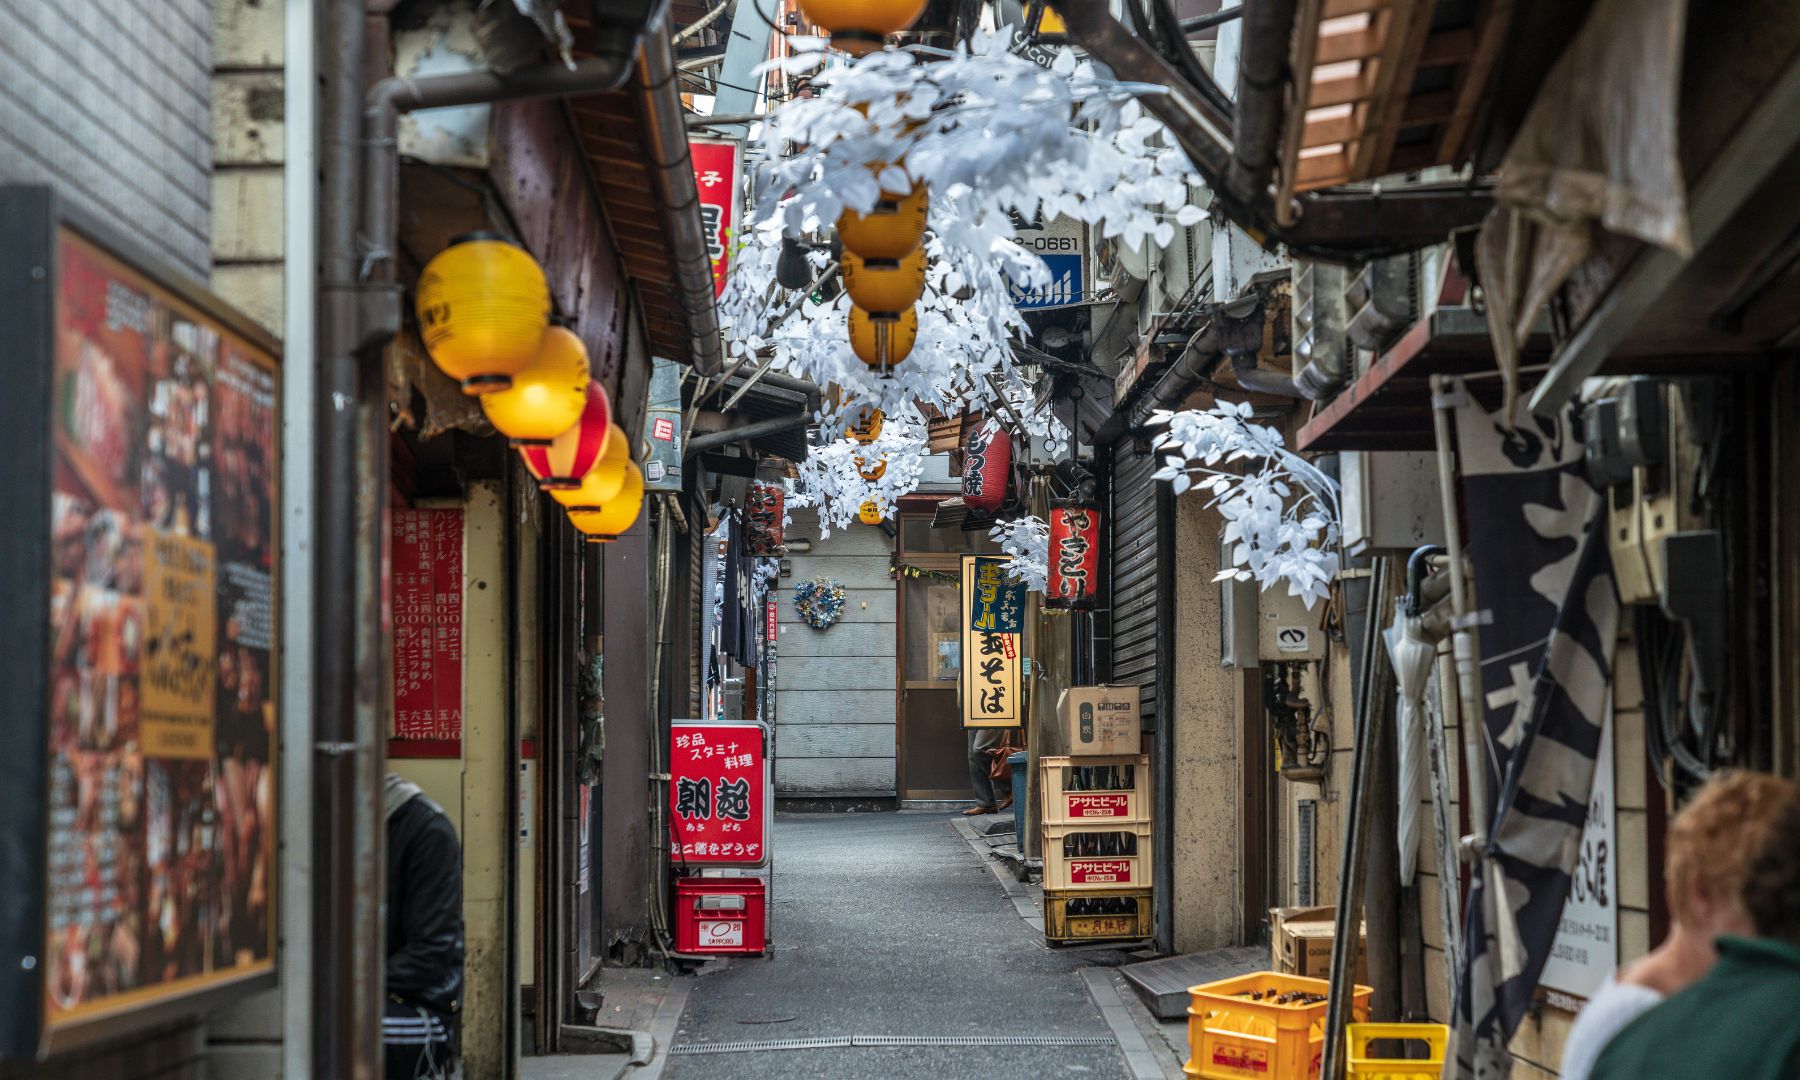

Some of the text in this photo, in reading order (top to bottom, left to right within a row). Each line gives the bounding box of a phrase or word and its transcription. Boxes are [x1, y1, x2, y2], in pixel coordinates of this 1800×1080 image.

[962, 430, 988, 497] もつ焼
[1059, 510, 1090, 602] やきとり
[420, 593, 432, 624] 三四〇
[436, 593, 448, 624] 四〇〇
[447, 593, 460, 624] 四二〇
[438, 709, 450, 741] 五七〇
[675, 733, 706, 749] 珍品
[690, 742, 739, 760] スタミナ
[724, 753, 754, 769] 料理
[1070, 796, 1127, 807] アサヒビール
[1072, 862, 1129, 873] アサヒビール
[733, 923, 741, 931] 20
